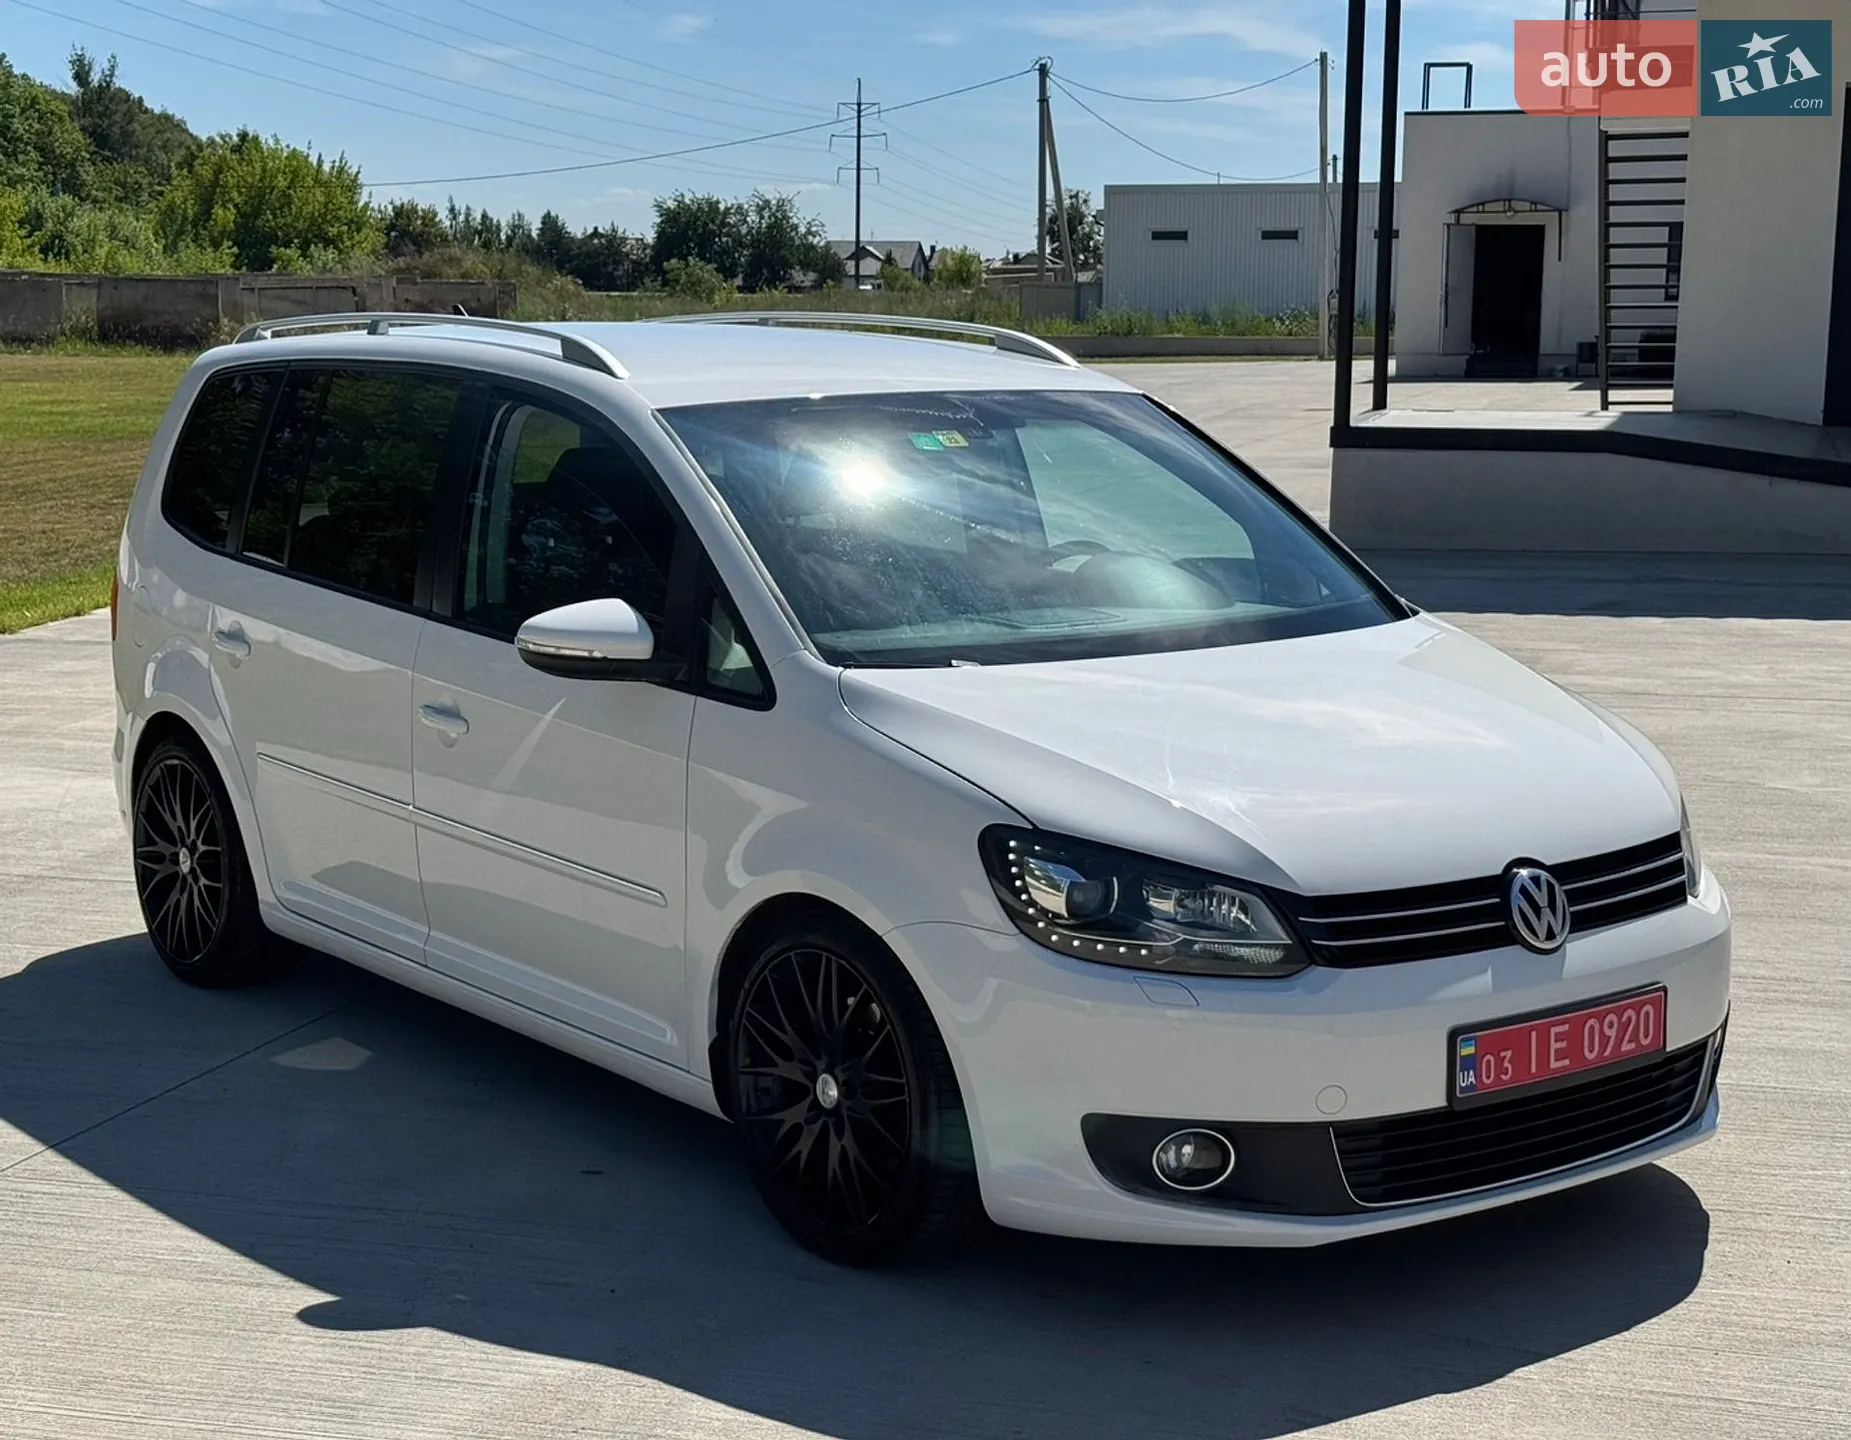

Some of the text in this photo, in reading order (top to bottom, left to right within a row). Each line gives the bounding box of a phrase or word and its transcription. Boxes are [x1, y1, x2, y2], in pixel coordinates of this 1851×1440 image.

[1511, 870, 1567, 946] VW
[1459, 1069, 1477, 1087] UA
[1481, 1003, 1655, 1085] 03 IE 0920
